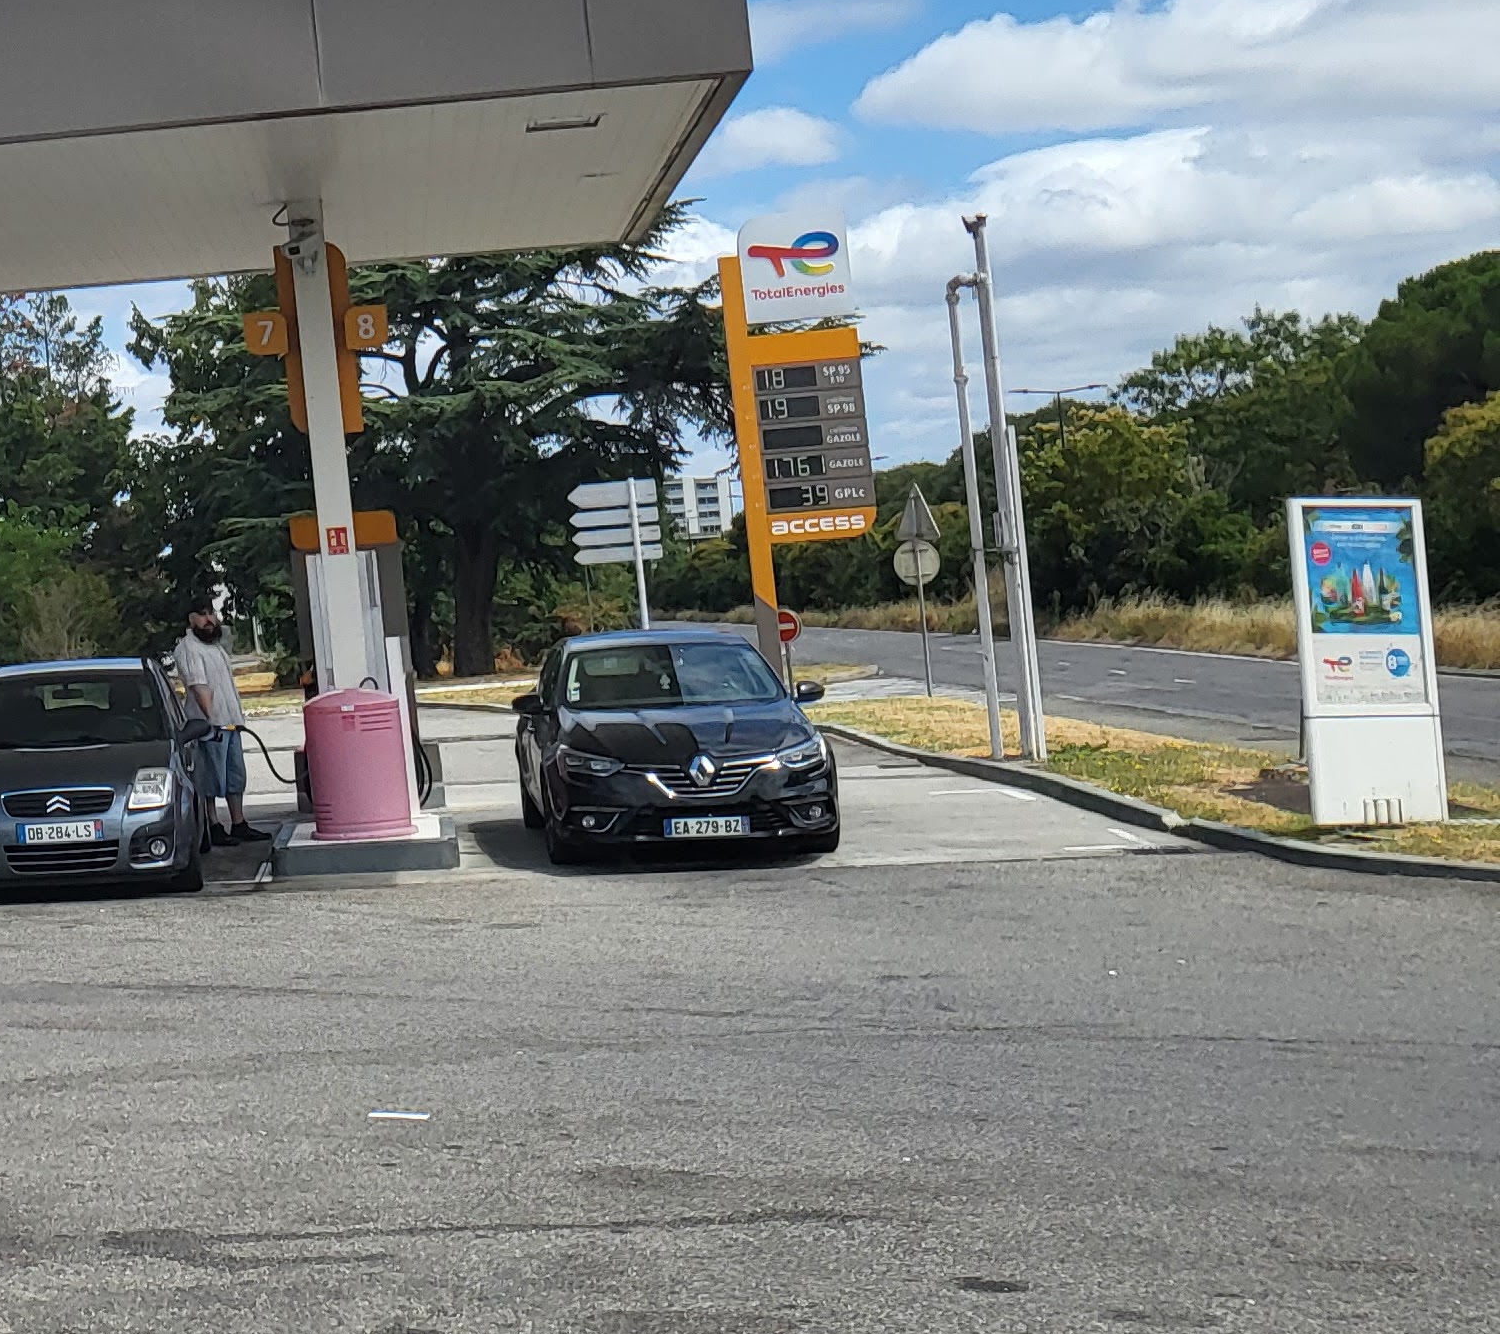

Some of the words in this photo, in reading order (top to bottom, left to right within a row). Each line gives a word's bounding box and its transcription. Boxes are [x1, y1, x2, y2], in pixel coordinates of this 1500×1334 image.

[751, 282, 845, 301] TotalEnergies
[257, 320, 274, 346] 7
[357, 314, 376, 340] 8
[827, 403, 840, 414] SP
[829, 457, 864, 469] GAZOLE
[834, 487, 866, 499] GPLc
[771, 514, 866, 536] access
